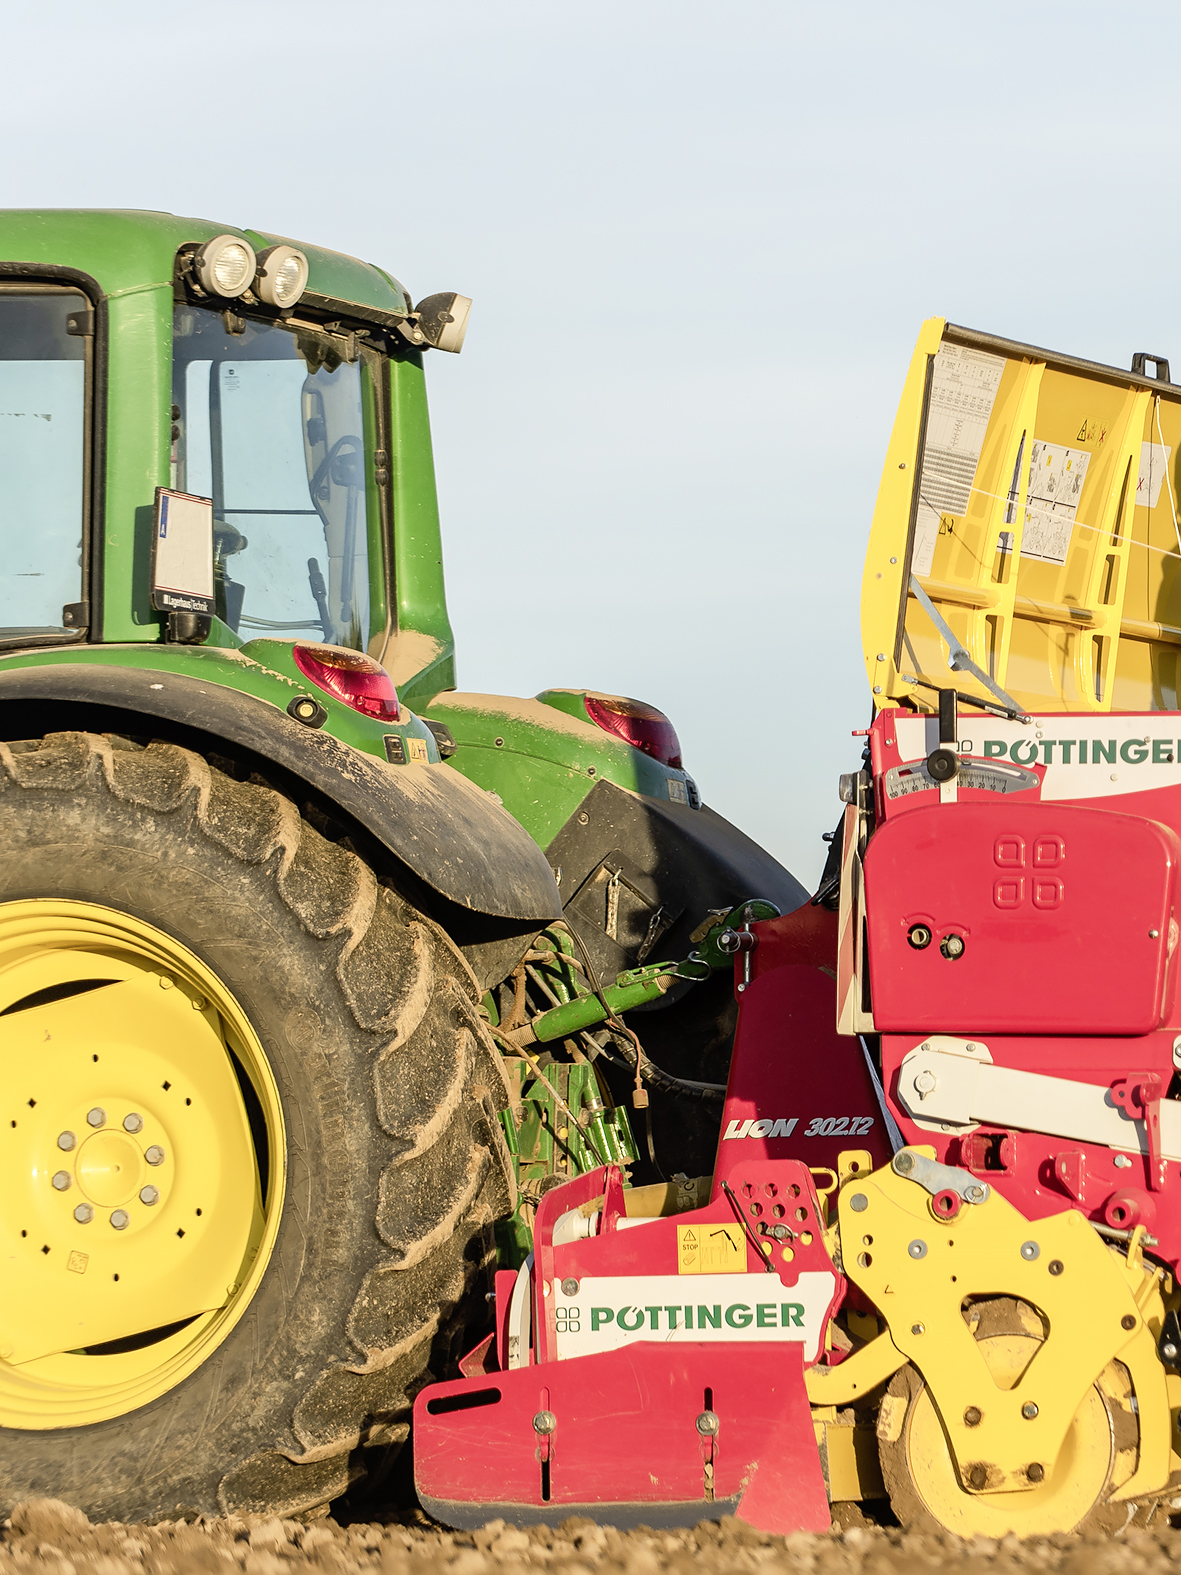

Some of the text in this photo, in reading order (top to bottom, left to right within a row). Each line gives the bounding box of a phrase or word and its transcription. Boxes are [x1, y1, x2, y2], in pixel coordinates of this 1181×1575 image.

[723, 1118, 799, 1140] LION
[683, 1243, 698, 1251] STOP
[590, 1303, 806, 1331] PÖTTINGER
